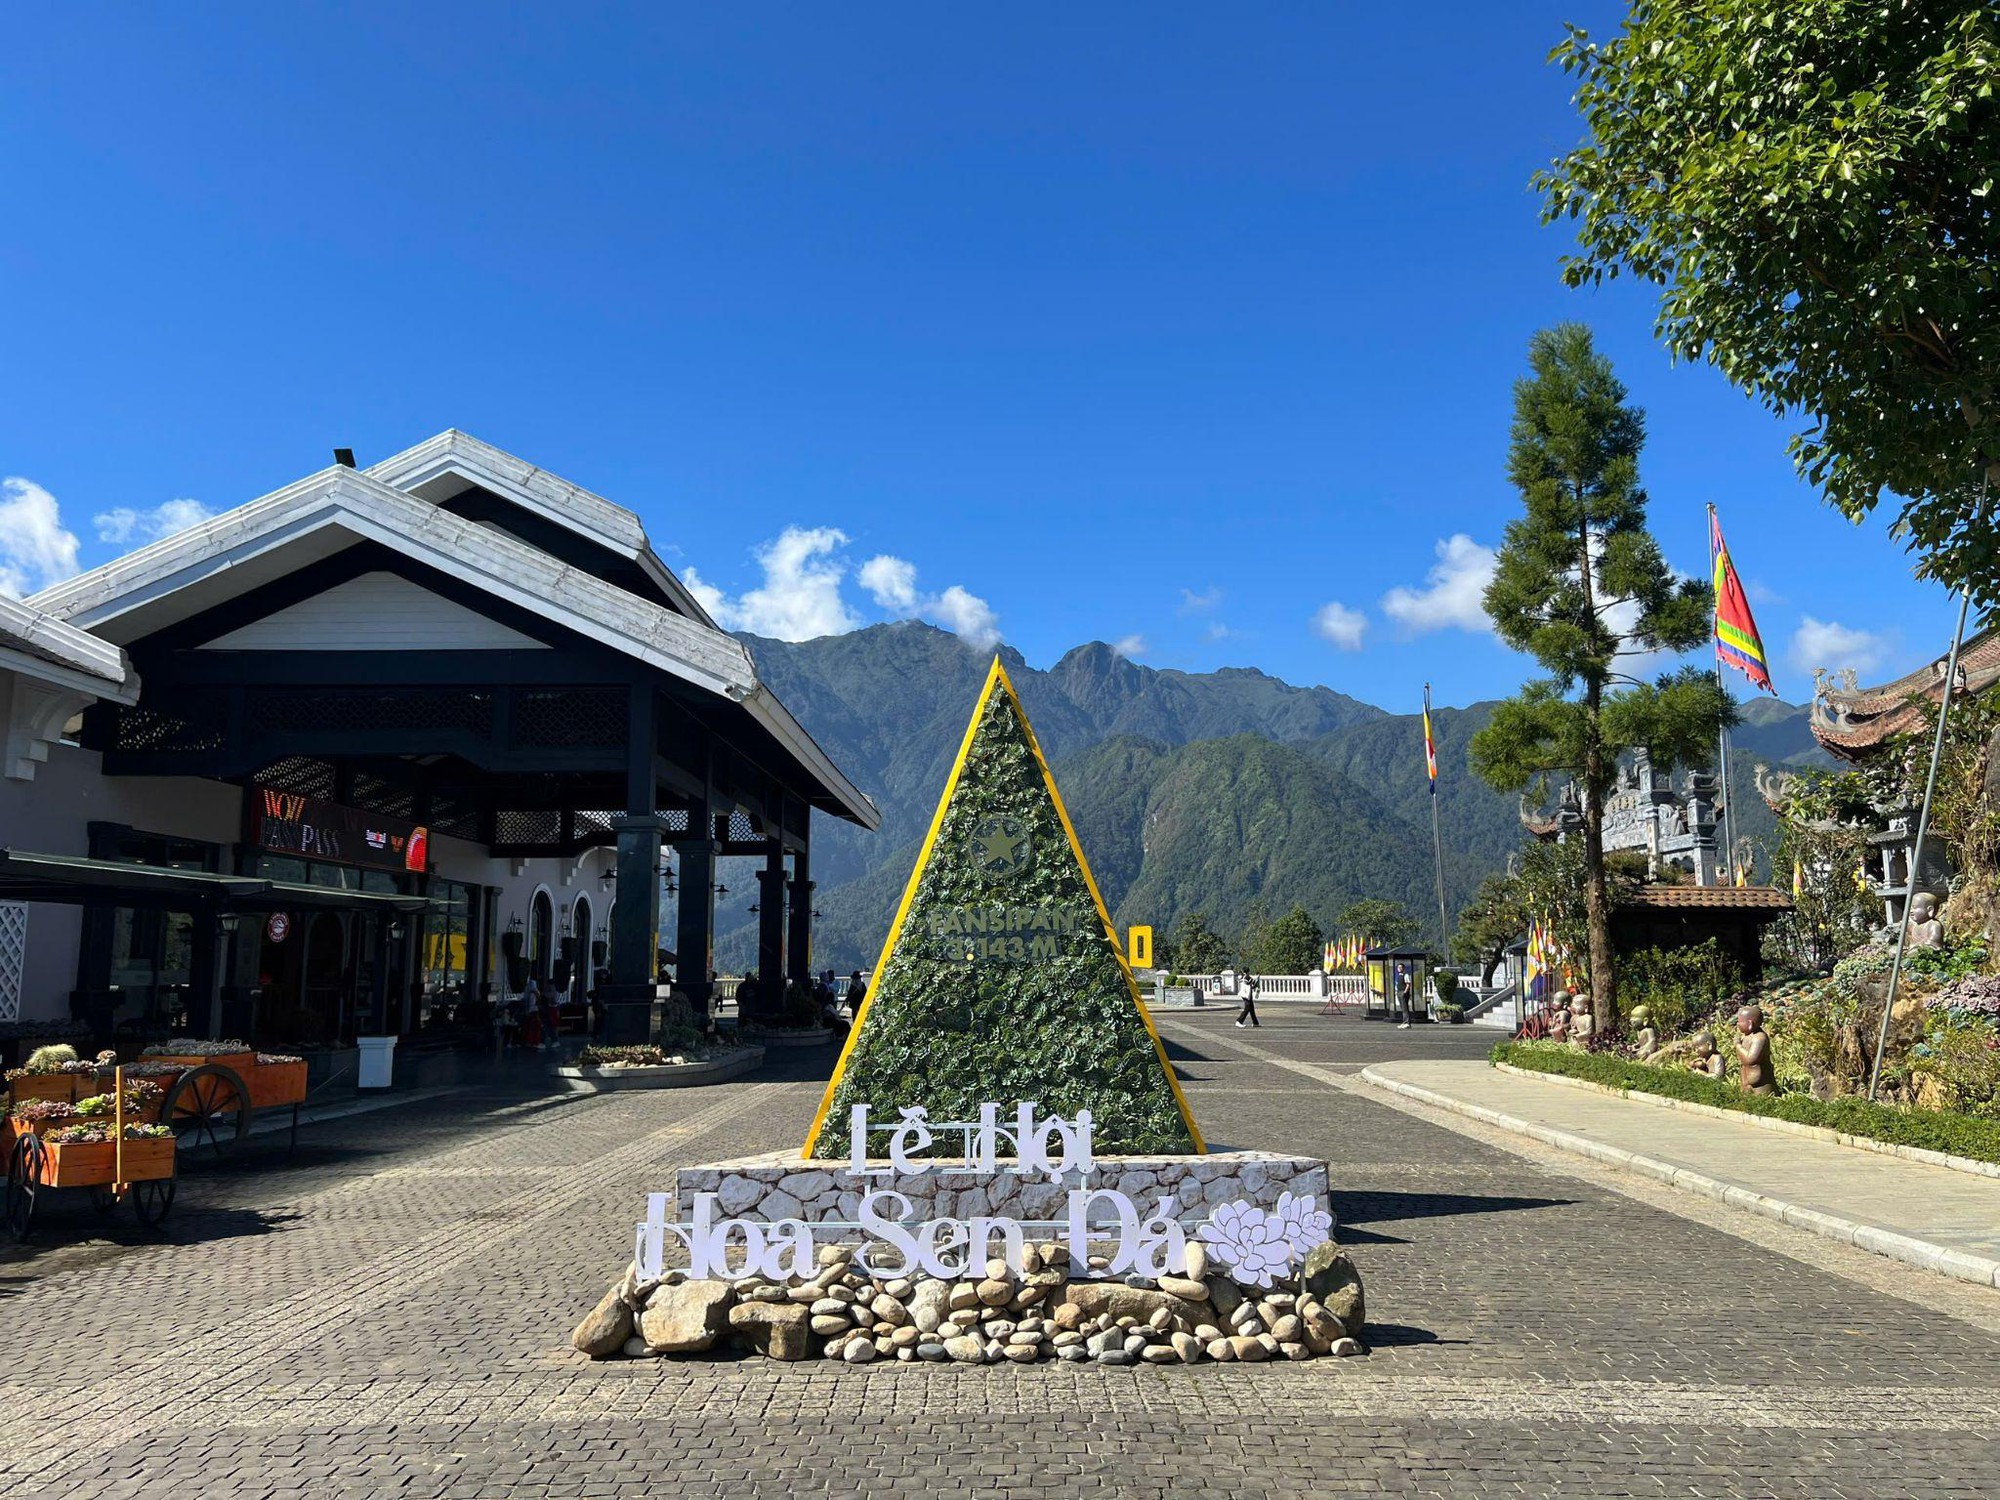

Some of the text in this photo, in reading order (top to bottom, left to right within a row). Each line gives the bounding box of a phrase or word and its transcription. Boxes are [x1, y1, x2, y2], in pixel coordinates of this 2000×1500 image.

[263, 789, 307, 822] WOW
[929, 906, 1077, 935] FANSIPAN
[846, 1102, 1097, 1184] Lễ Hội
[635, 1189, 1189, 1281] Hoa Sen Đá
